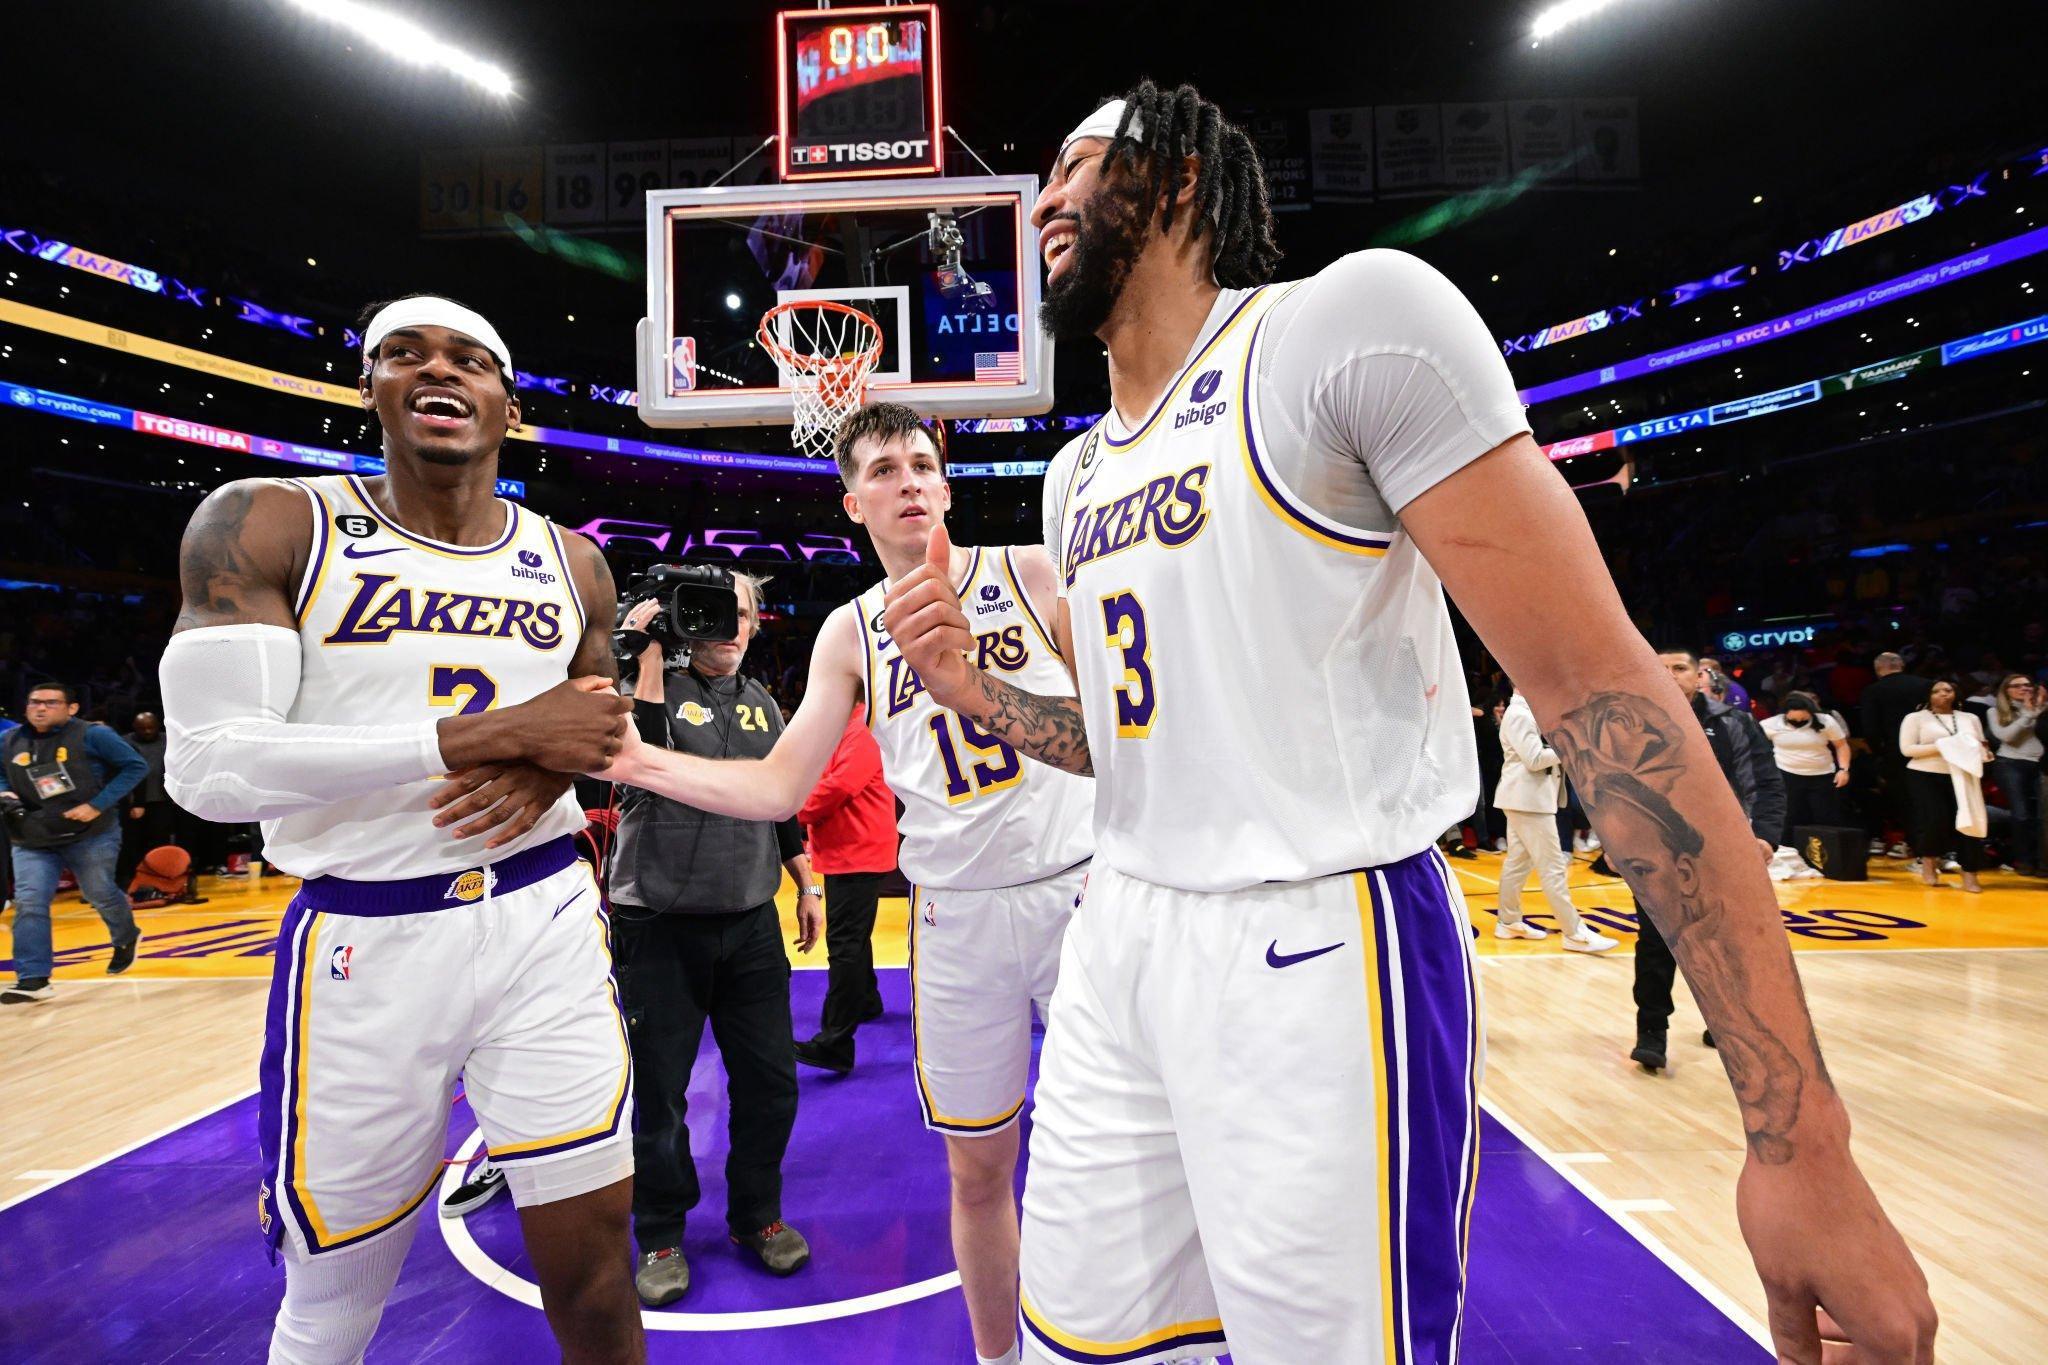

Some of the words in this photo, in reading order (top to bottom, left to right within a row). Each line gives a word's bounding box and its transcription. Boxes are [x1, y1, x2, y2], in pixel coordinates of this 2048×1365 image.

[830, 26, 889, 64] 0.0
[829, 139, 929, 162] TISSOT
[494, 178, 529, 211] 16
[556, 175, 592, 209] 18
[1649, 341, 1721, 367] Congratulations
[1722, 339, 1733, 347] to
[1736, 326, 1770, 344] KYCC
[1774, 320, 1791, 333] LA
[1794, 315, 1813, 327] our
[1814, 296, 1866, 319] Honorary
[1867, 271, 1938, 302] Community
[1940, 254, 1991, 278] Partner
[272, 377, 304, 391] KYCC
[308, 385, 325, 395] LA
[37, 396, 121, 420] crypto.com
[1174, 401, 1227, 429] bibigo
[140, 415, 247, 449] TOSHIBA
[1641, 414, 1703, 436] DELTA
[644, 446, 692, 460] Congratulations
[701, 454, 722, 462] KYCC
[746, 458, 773, 468] Honorary
[774, 460, 806, 470] Community
[806, 462, 827, 470] Partner
[1004, 464, 1024, 474] 0.0
[345, 518, 367, 535] 6
[511, 565, 556, 585] bibigo
[321, 571, 566, 652] LAKERS
[976, 600, 1014, 615] bibigo
[886, 625, 1031, 721] LARS
[1098, 587, 1158, 739] 3
[735, 704, 769, 732] 24
[928, 710, 1026, 806] 15
